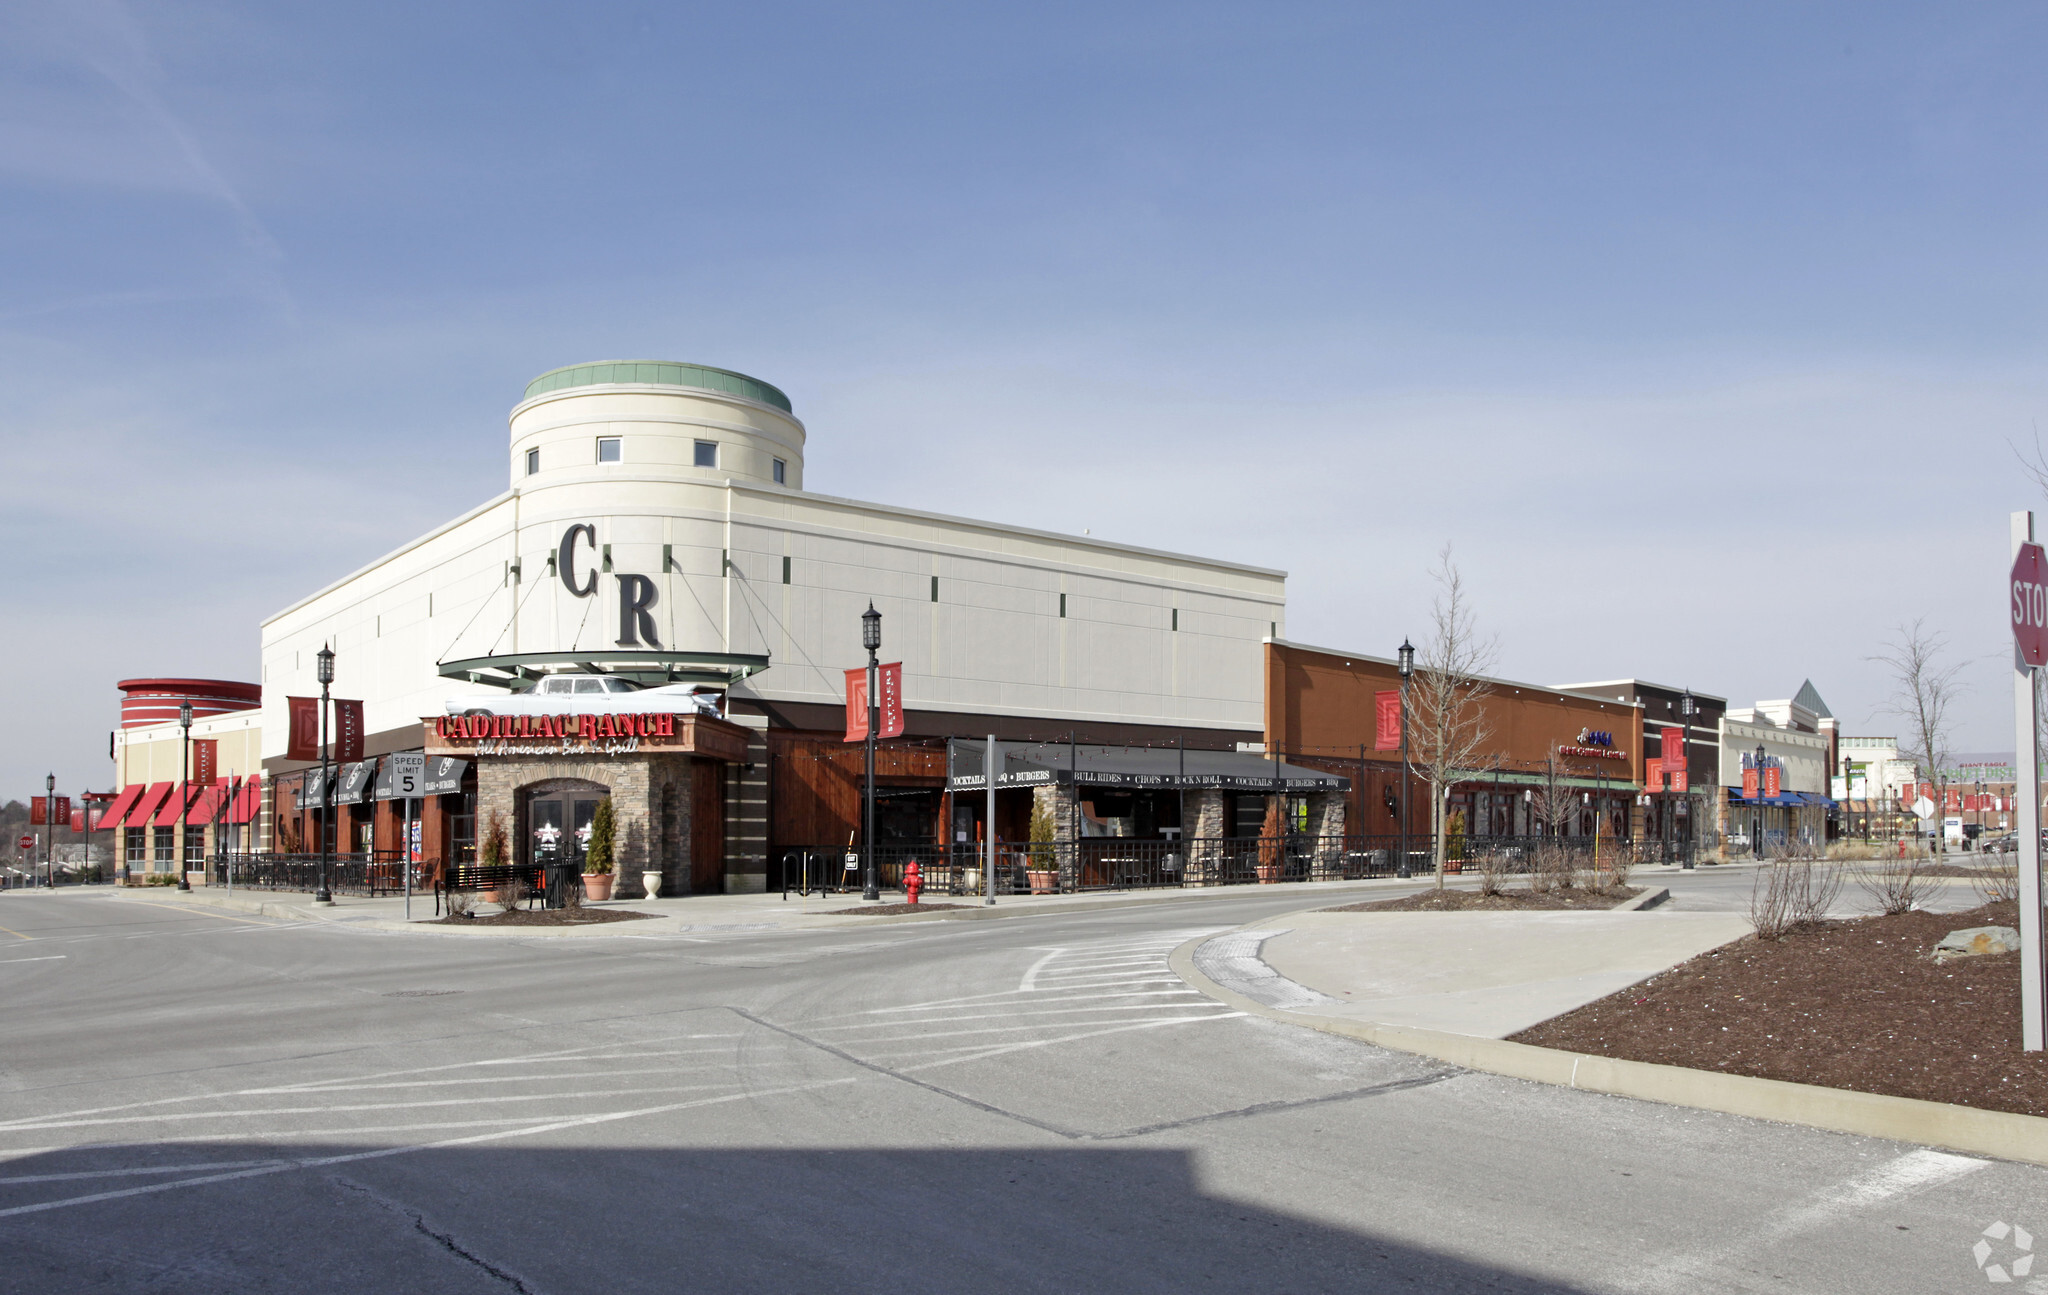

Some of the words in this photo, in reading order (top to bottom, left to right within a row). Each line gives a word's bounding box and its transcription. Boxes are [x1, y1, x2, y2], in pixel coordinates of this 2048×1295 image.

[2013, 580, 2048, 628] STO
[885, 670, 893, 732] SETTLERS
[436, 714, 571, 739] CADILLAC
[577, 712, 675, 741] RANCH
[474, 738, 496, 756] All
[498, 739, 558, 756] American
[561, 737, 585, 755] Bar
[605, 736, 640, 757] Grill
[394, 757, 423, 765] SPEED
[397, 766, 421, 774] LIMIT
[1016, 770, 1050, 782] BURGERS
[403, 776, 415, 792] 5
[1074, 772, 1096, 782] BULL
[1097, 773, 1122, 783] RIDES
[1134, 775, 1161, 784] CHOPS
[1202, 775, 1222, 784] ROLL
[1235, 777, 1273, 787] COCKTAILS
[1286, 778, 1316, 787] BURGERS
[1326, 778, 1339, 788] BBQ
